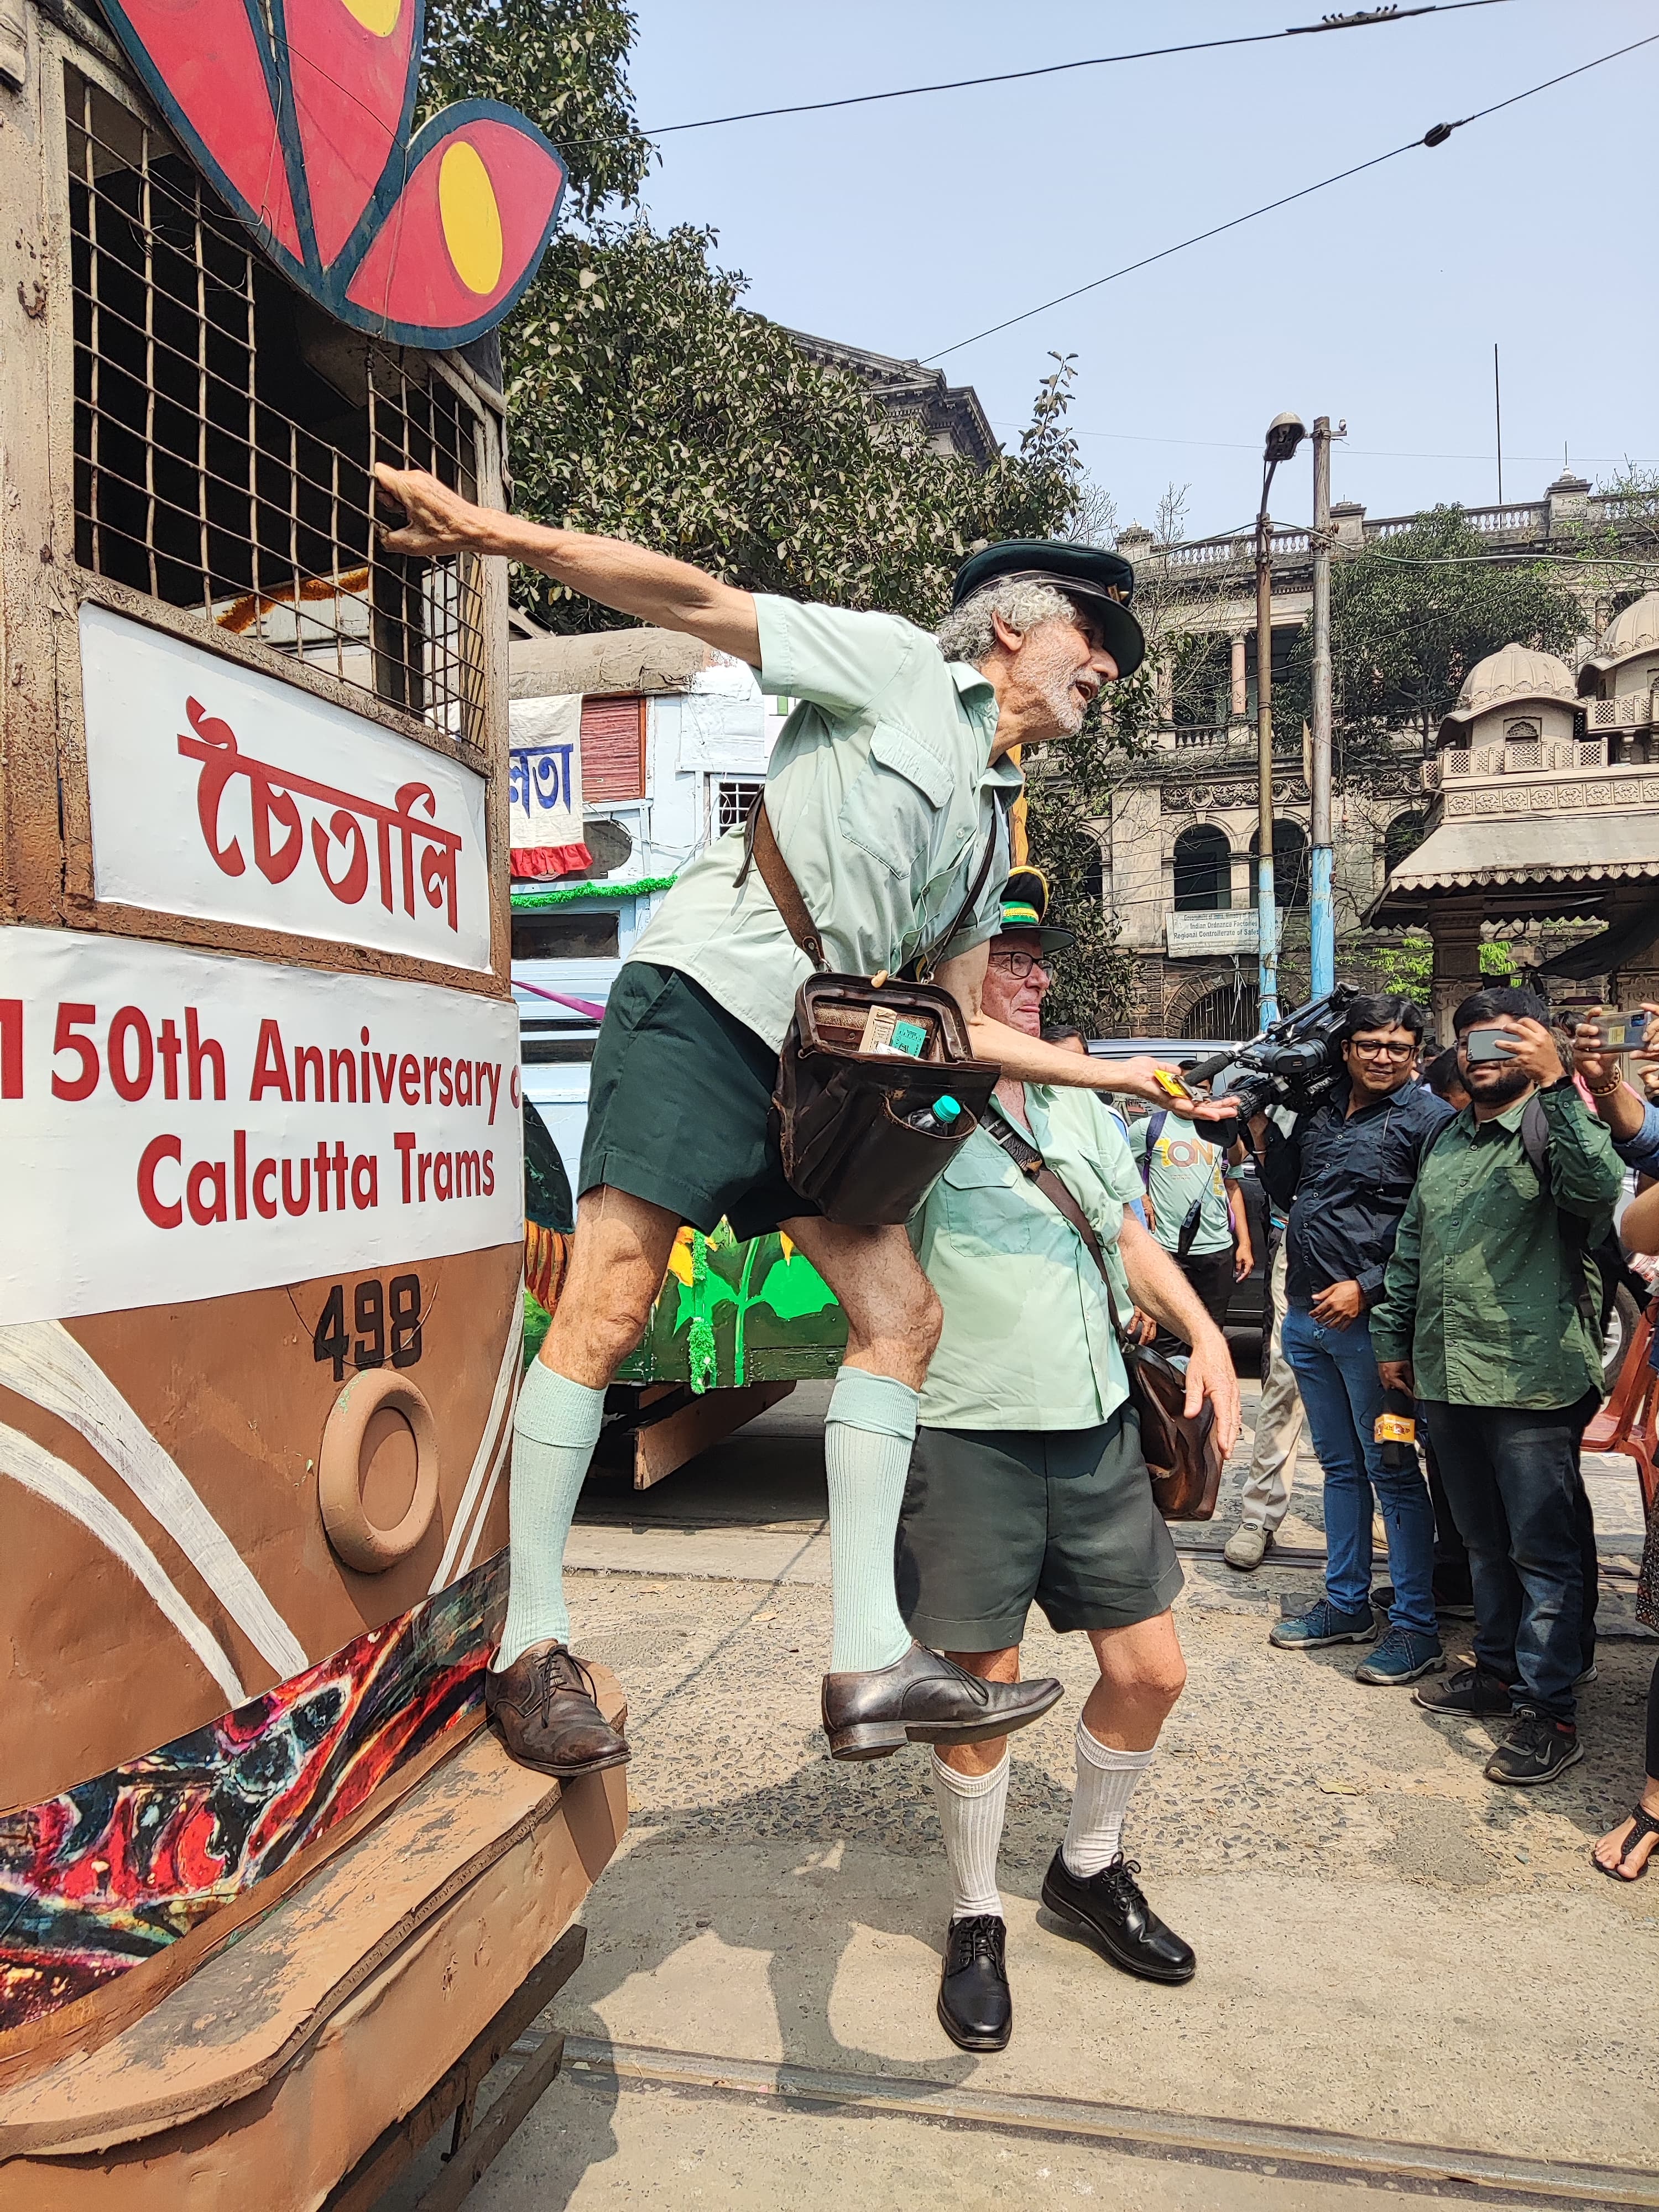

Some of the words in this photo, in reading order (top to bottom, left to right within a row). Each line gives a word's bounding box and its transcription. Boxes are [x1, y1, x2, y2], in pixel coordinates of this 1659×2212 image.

[177, 695, 462, 933] চৈতালি
[1173, 931, 1197, 940] Regional
[0, 998, 226, 1103] 150th
[250, 1018, 502, 1125] Anniversary
[137, 1130, 379, 1230] Calcutta
[393, 1131, 495, 1204] Trams
[313, 1274, 422, 1382] 498
